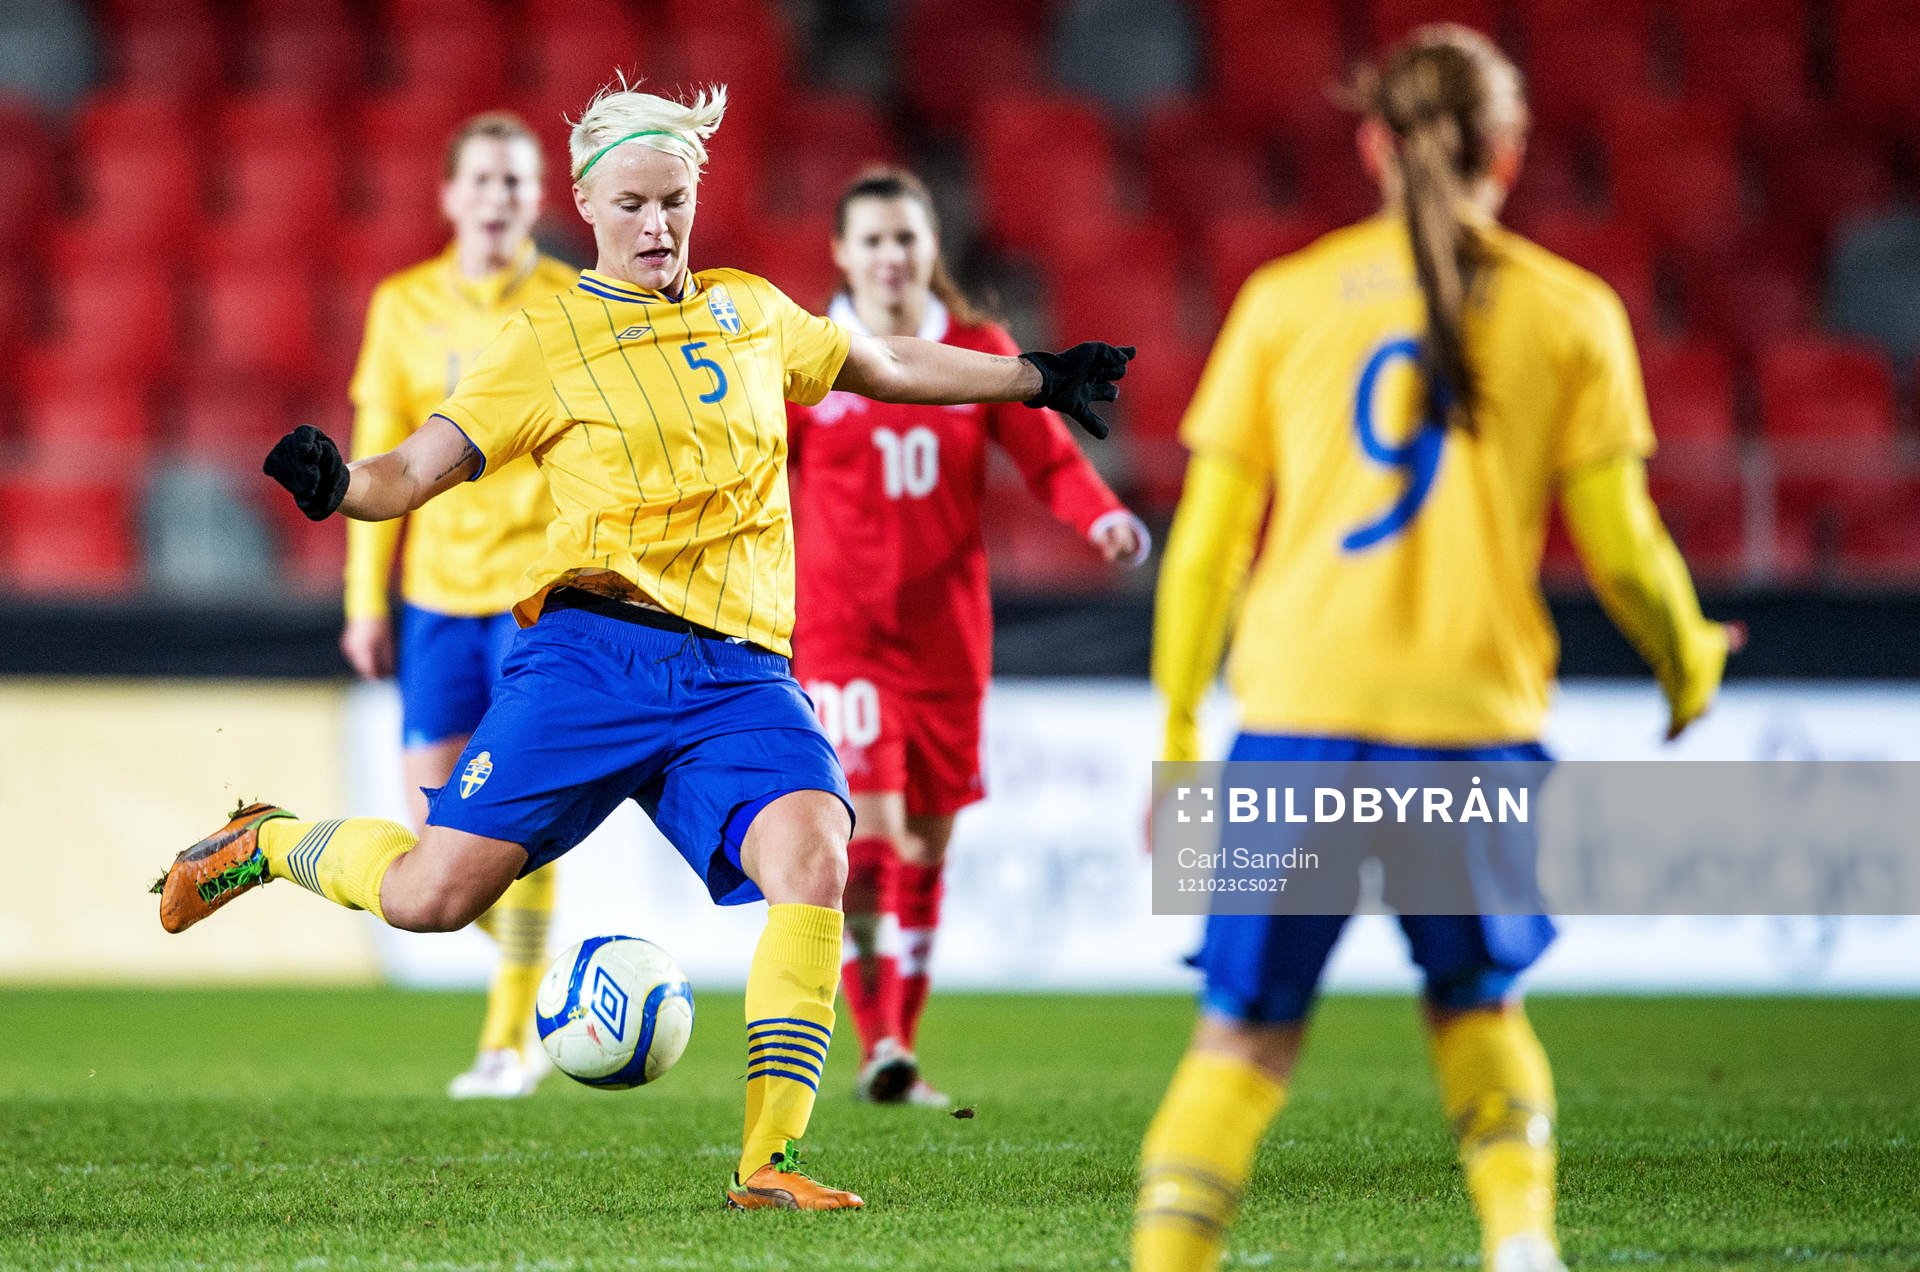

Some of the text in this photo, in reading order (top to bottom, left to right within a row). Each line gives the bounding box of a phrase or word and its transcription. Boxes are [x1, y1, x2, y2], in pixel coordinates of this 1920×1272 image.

[680, 341, 729, 404] 5
[872, 427, 939, 498] 10
[1341, 339, 1447, 552] 9
